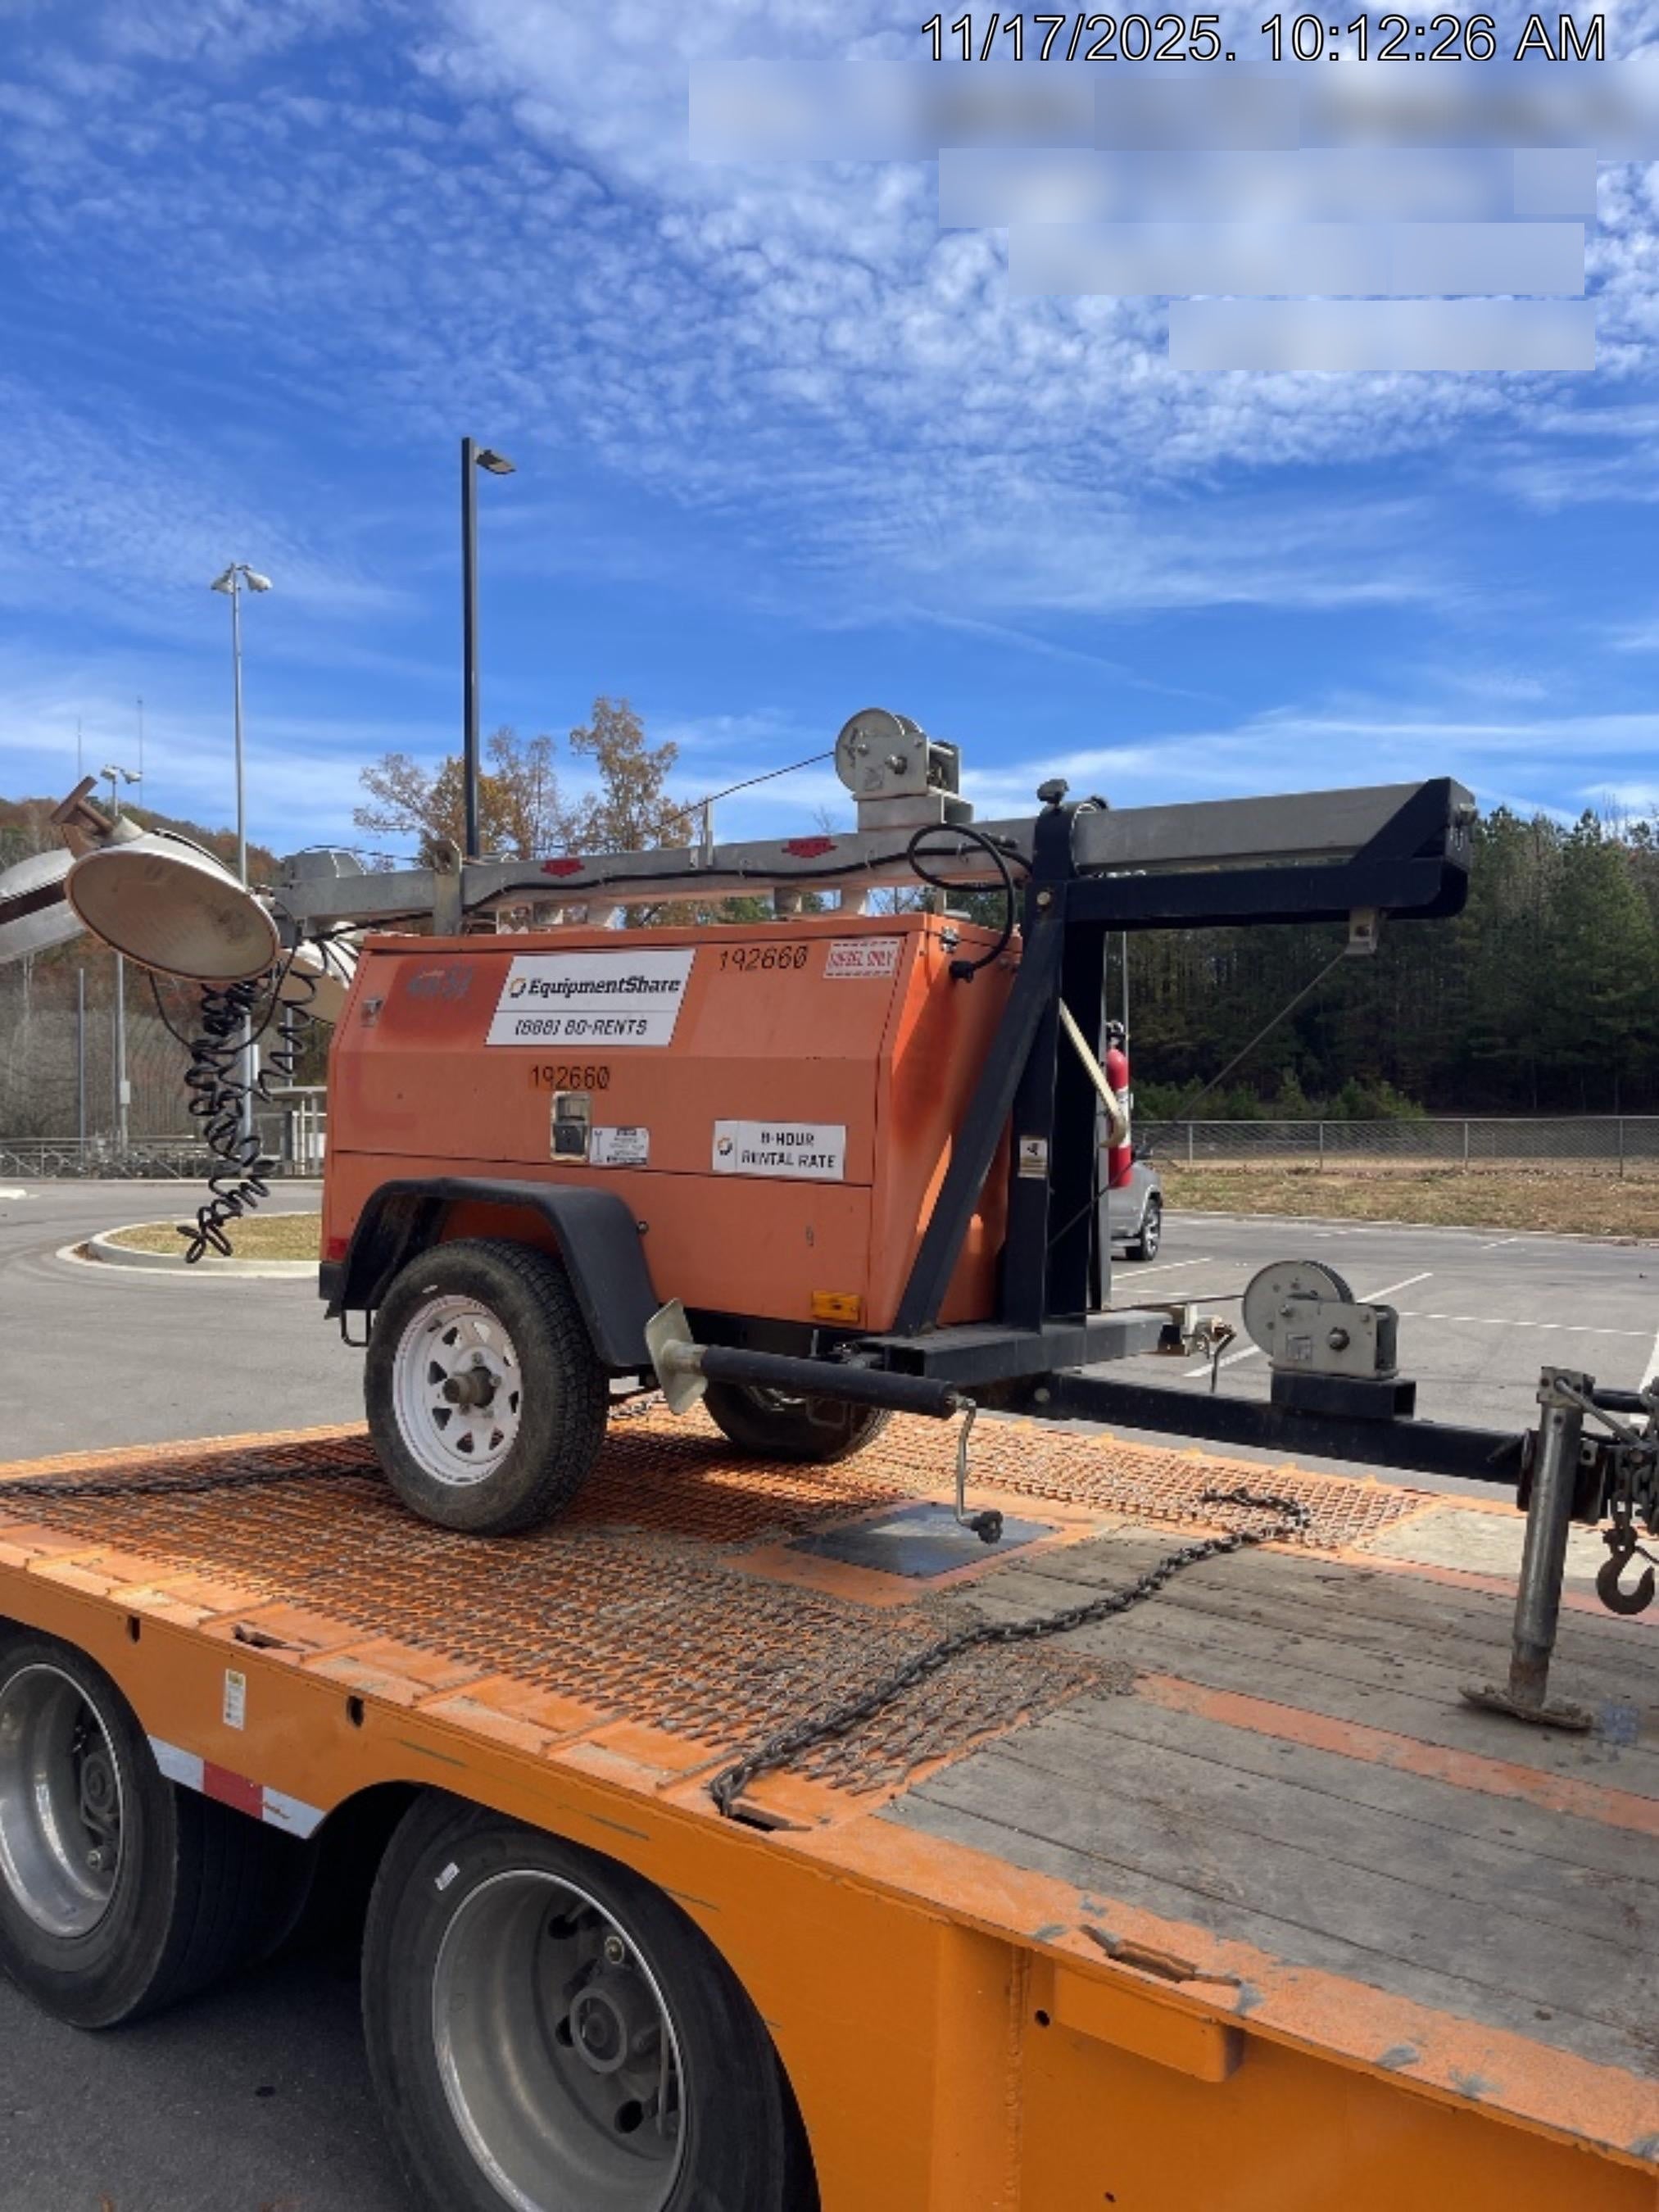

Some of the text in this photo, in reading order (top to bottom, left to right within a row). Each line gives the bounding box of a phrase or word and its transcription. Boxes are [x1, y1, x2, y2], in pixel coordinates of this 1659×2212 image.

[719, 945, 807, 972] 192660
[528, 976, 681, 998] EquipmentShare
[531, 1066, 610, 1090] 192660
[741, 1149, 836, 1168] RENTAL RATE
